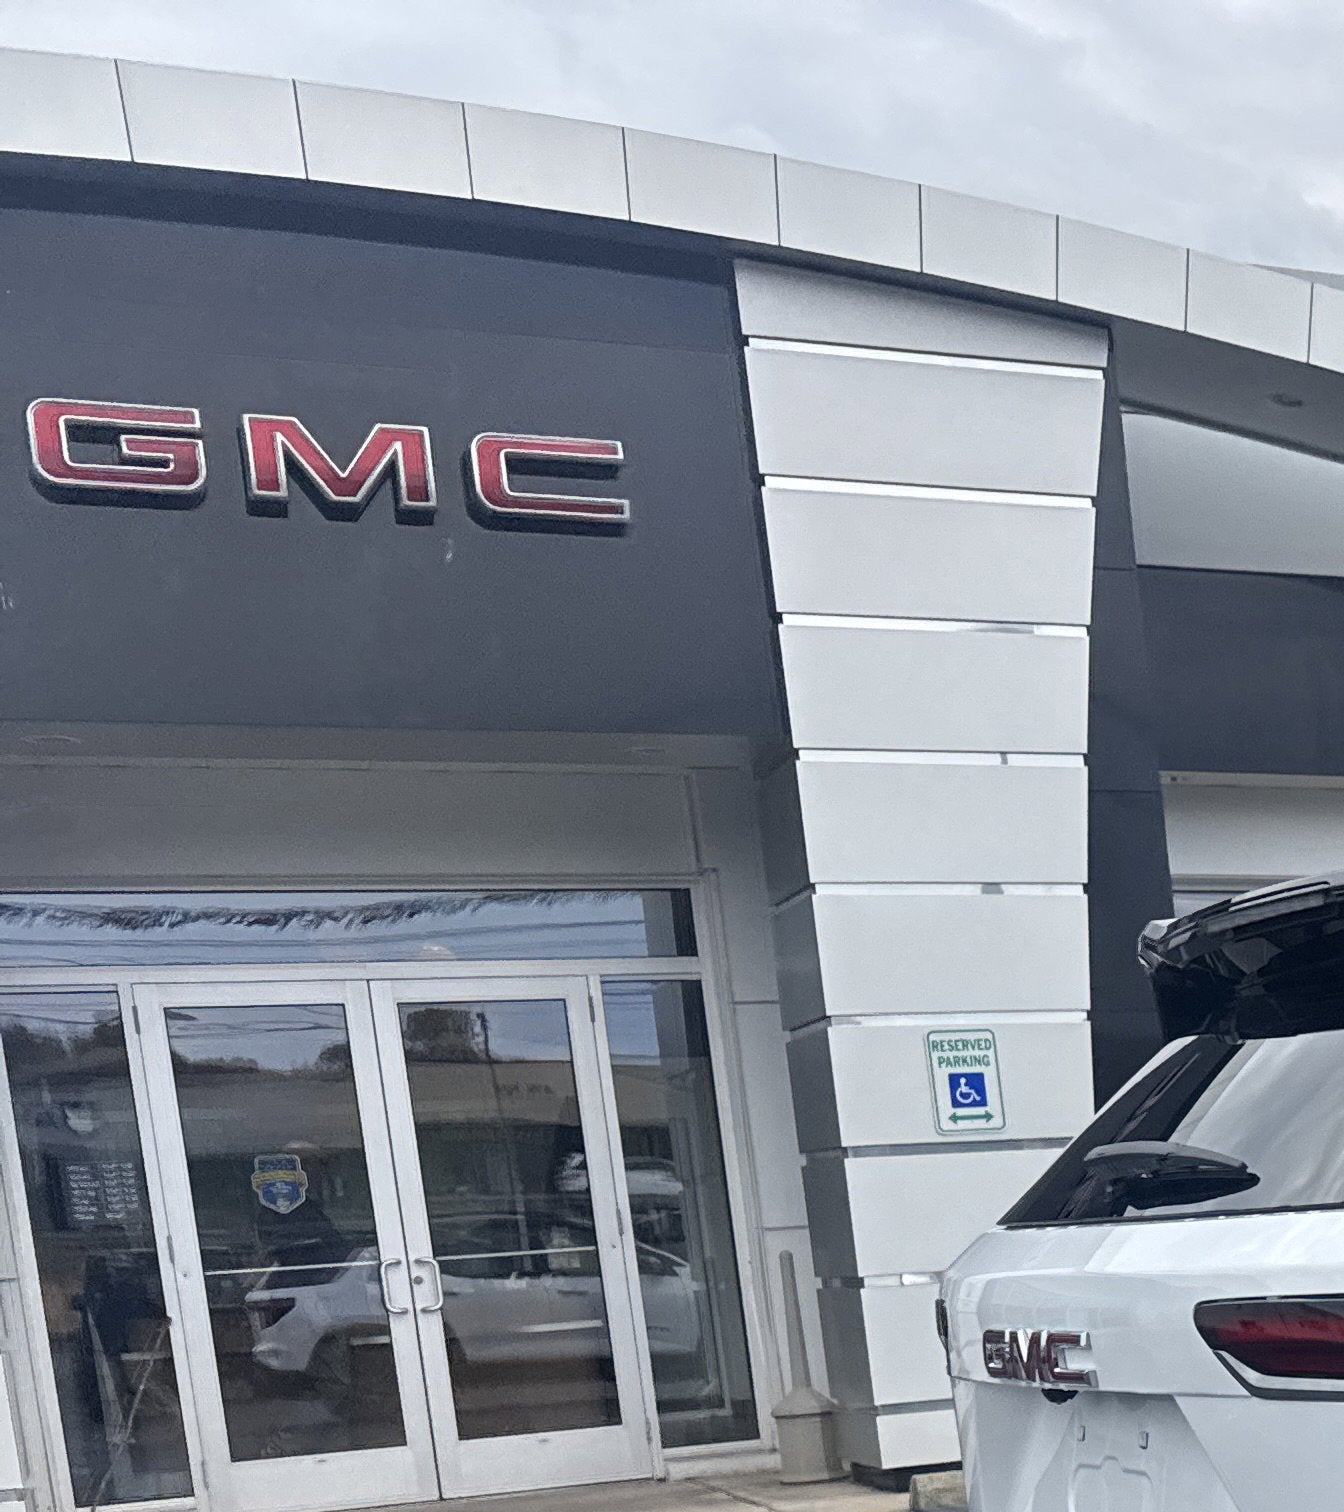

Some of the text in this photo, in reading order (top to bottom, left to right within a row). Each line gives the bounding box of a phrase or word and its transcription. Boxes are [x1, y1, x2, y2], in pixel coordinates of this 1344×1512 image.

[27, 398, 631, 520] GMC
[931, 1038, 992, 1053] RESERVED
[937, 1054, 991, 1069] PARKING
[983, 1329, 1098, 1387] GMC
